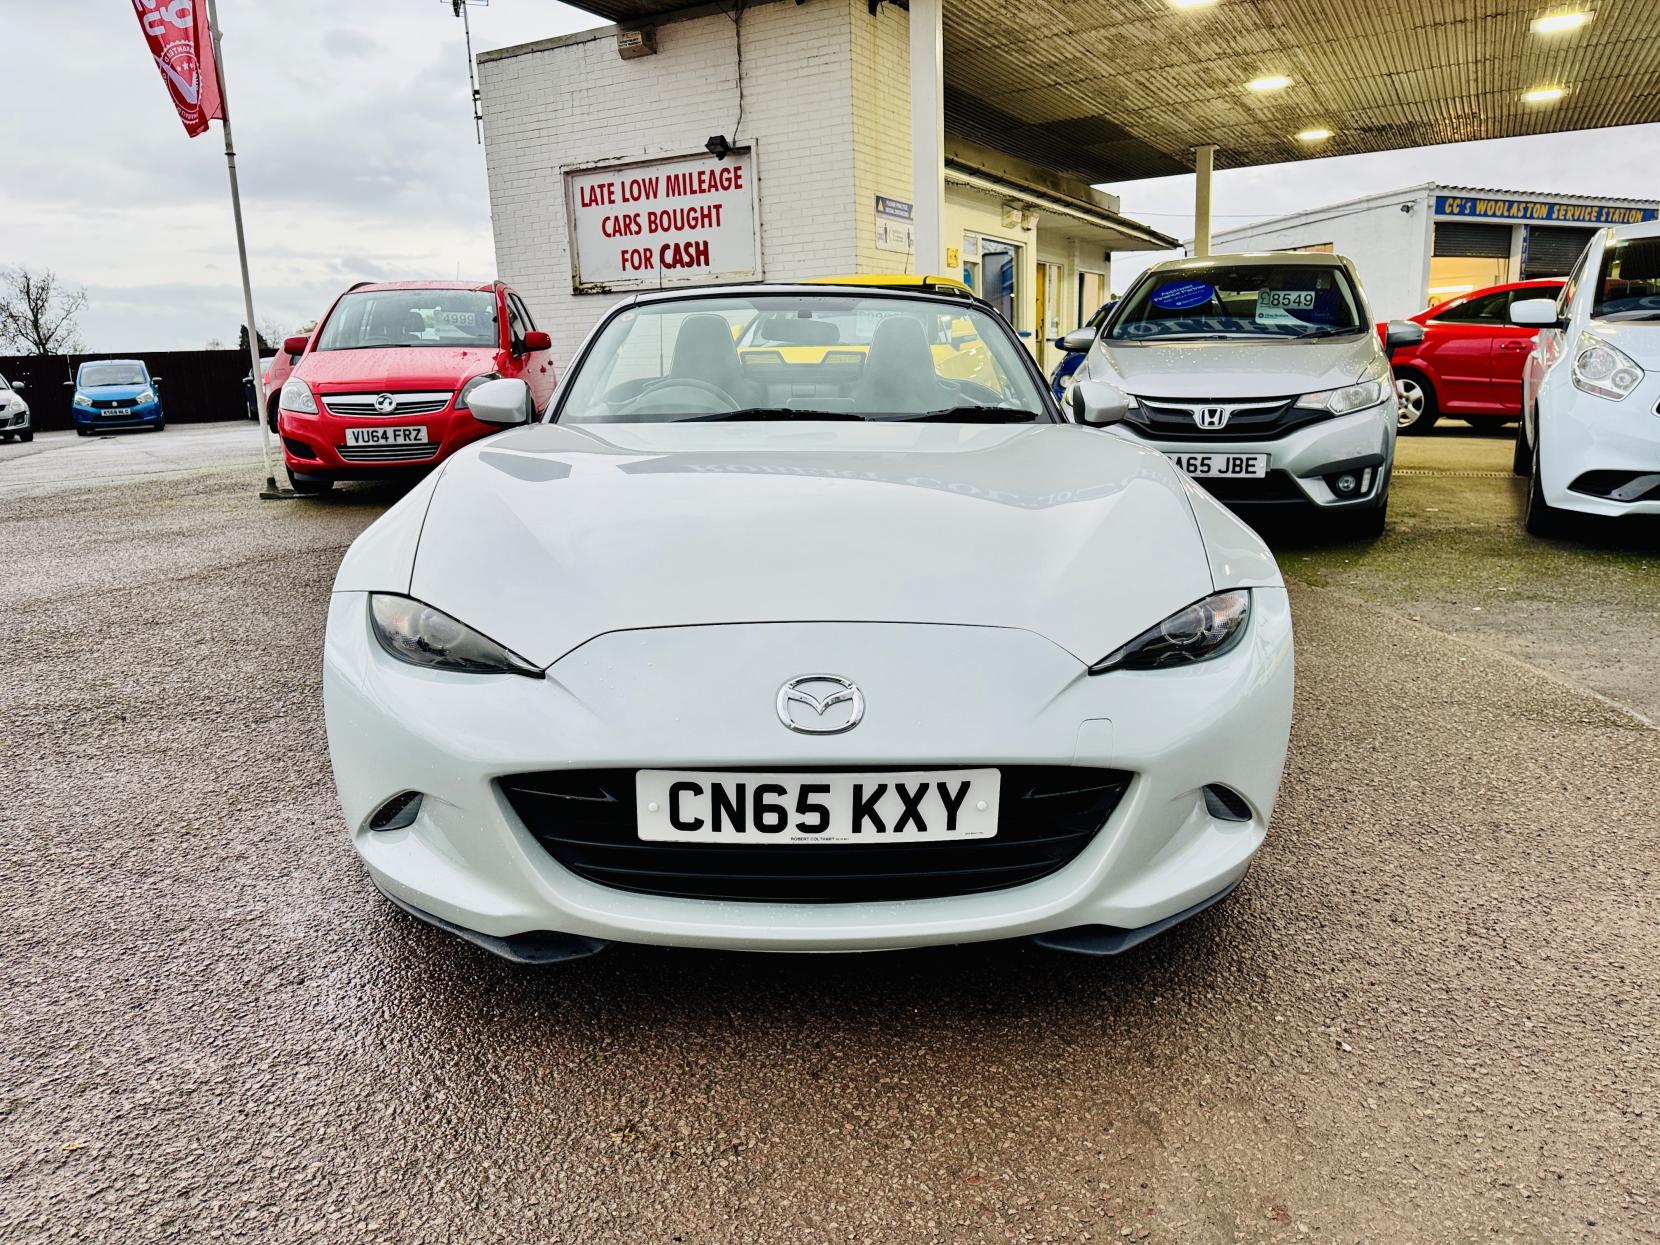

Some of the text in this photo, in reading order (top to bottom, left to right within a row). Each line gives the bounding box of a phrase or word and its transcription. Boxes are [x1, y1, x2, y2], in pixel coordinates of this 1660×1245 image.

[580, 165, 743, 208] LATE LOW MILEAGE
[601, 204, 722, 238] CARS BOUGHT
[1444, 197, 1470, 214] CC's
[1475, 199, 1548, 219] WOOLASTON
[1552, 205, 1597, 221] SERVICE
[1600, 208, 1644, 224] STATION
[621, 240, 710, 271] FOR CASH
[352, 428, 422, 443] VU64 FRZ
[1168, 456, 1258, 474] A65 JBE
[668, 780, 972, 835] CN65 KXY
